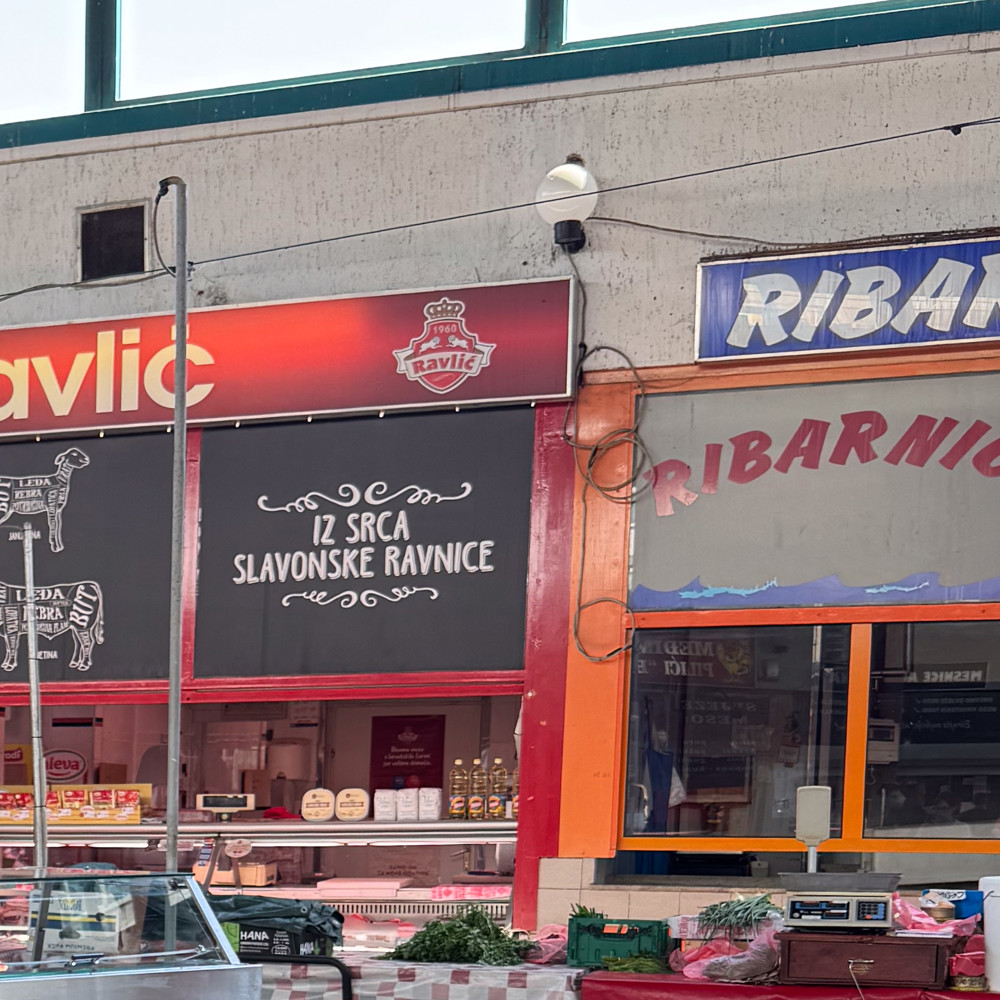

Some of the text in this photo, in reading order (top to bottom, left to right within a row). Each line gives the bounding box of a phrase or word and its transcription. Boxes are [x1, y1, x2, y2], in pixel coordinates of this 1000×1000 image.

[433, 324, 457, 334] 1960
[412, 353, 477, 374] Ravlić
[313, 509, 411, 546] IZ SRCA
[232, 540, 495, 585] SLAVONSKE RAVNICE
[69, 585, 98, 629] BUT
[240, 930, 269, 941] HANA
